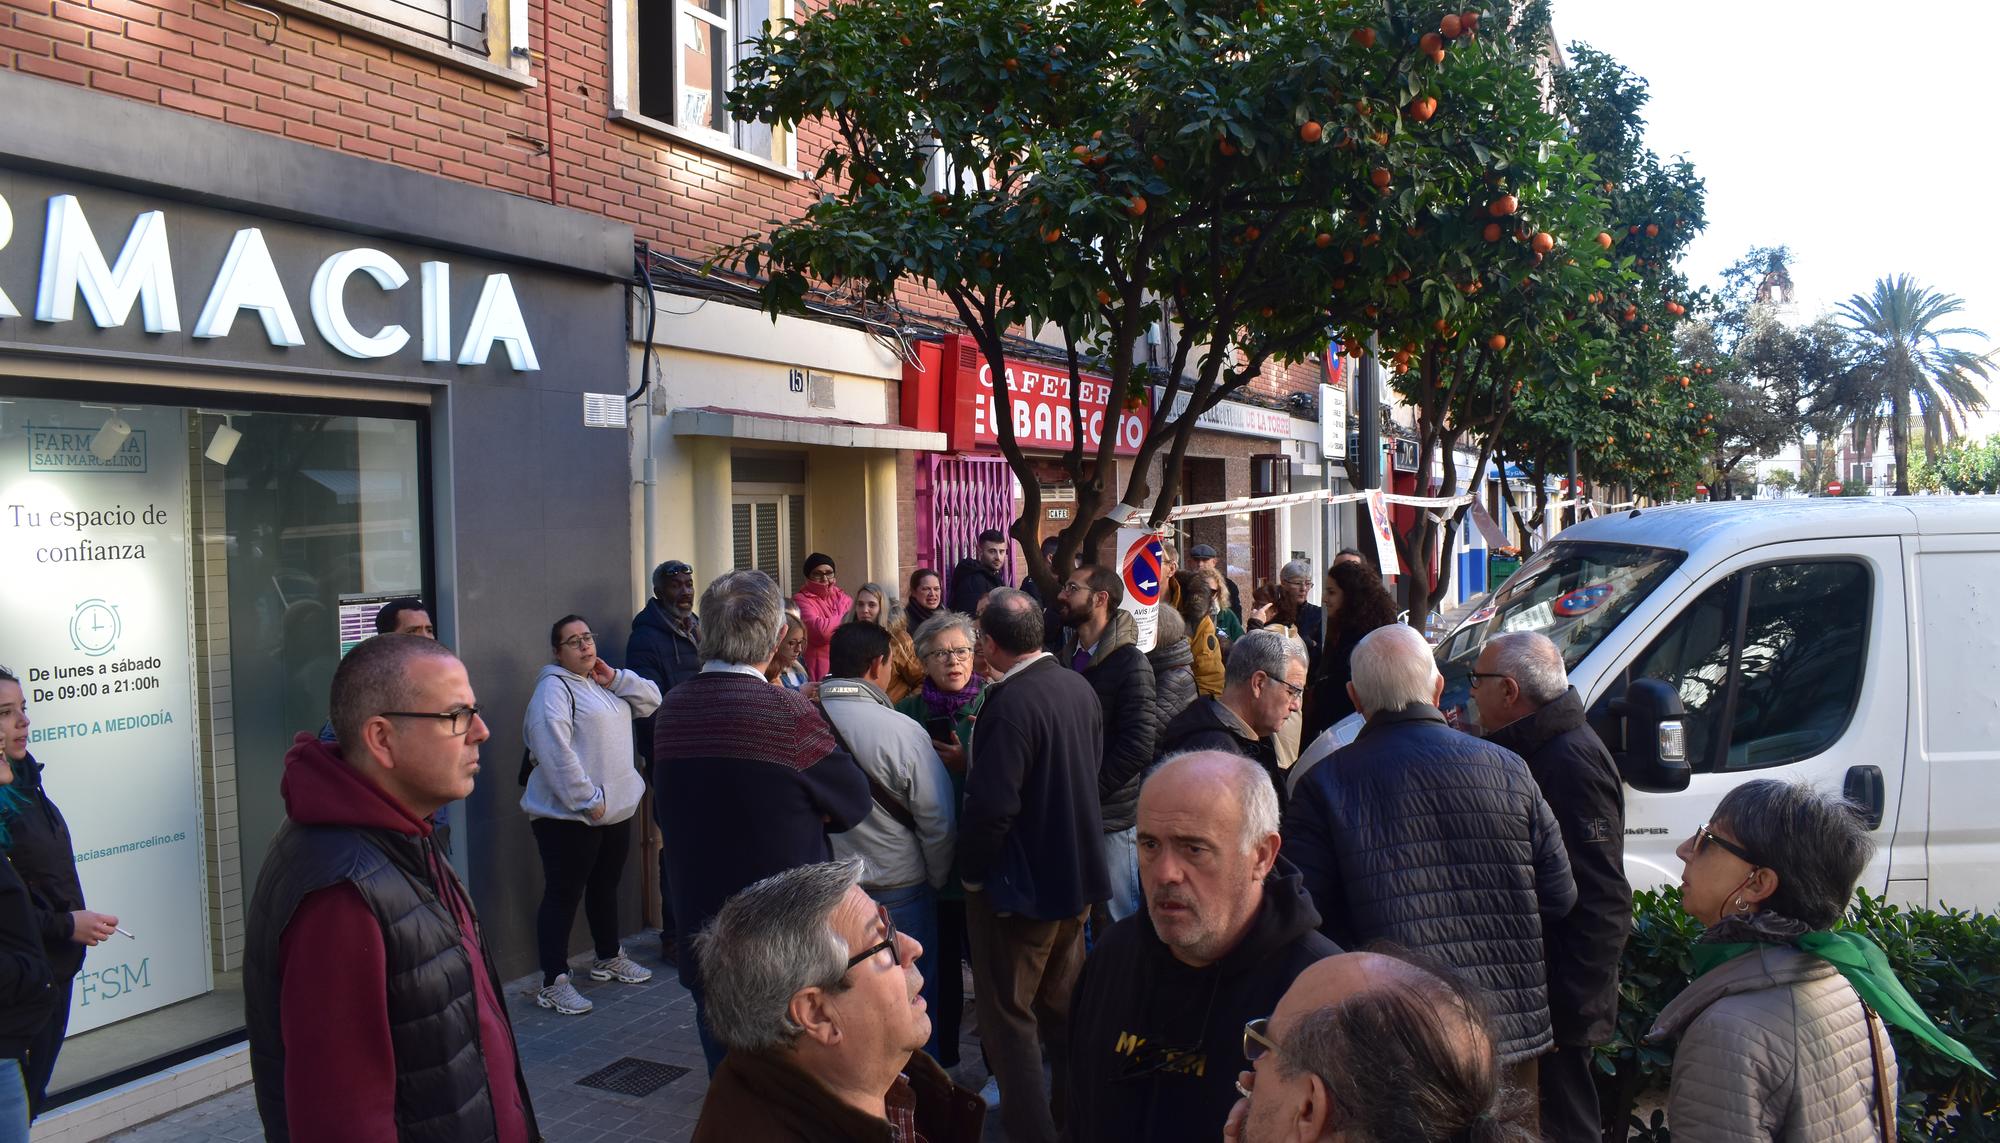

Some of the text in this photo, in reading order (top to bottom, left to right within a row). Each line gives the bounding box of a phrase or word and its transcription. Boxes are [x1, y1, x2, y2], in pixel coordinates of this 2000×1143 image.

[979, 363, 1112, 406] CAFETER
[1013, 399, 1143, 449] BARECTO
[34, 432, 140, 453] FARMIA
[35, 453, 66, 467] SAN
[8, 503, 168, 532] Tu espacio de
[36, 539, 147, 564] confianza
[29, 656, 162, 682] De lunes a sábado
[33, 676, 160, 702] De 09:00 a 21:00h
[92, 721, 102, 735] A
[105, 709, 174, 733] MEDIODÍA
[1623, 826, 1670, 835] UMPER
[73, 831, 186, 863] aciasanmarcelino.es
[76, 957, 152, 1007] FSM
